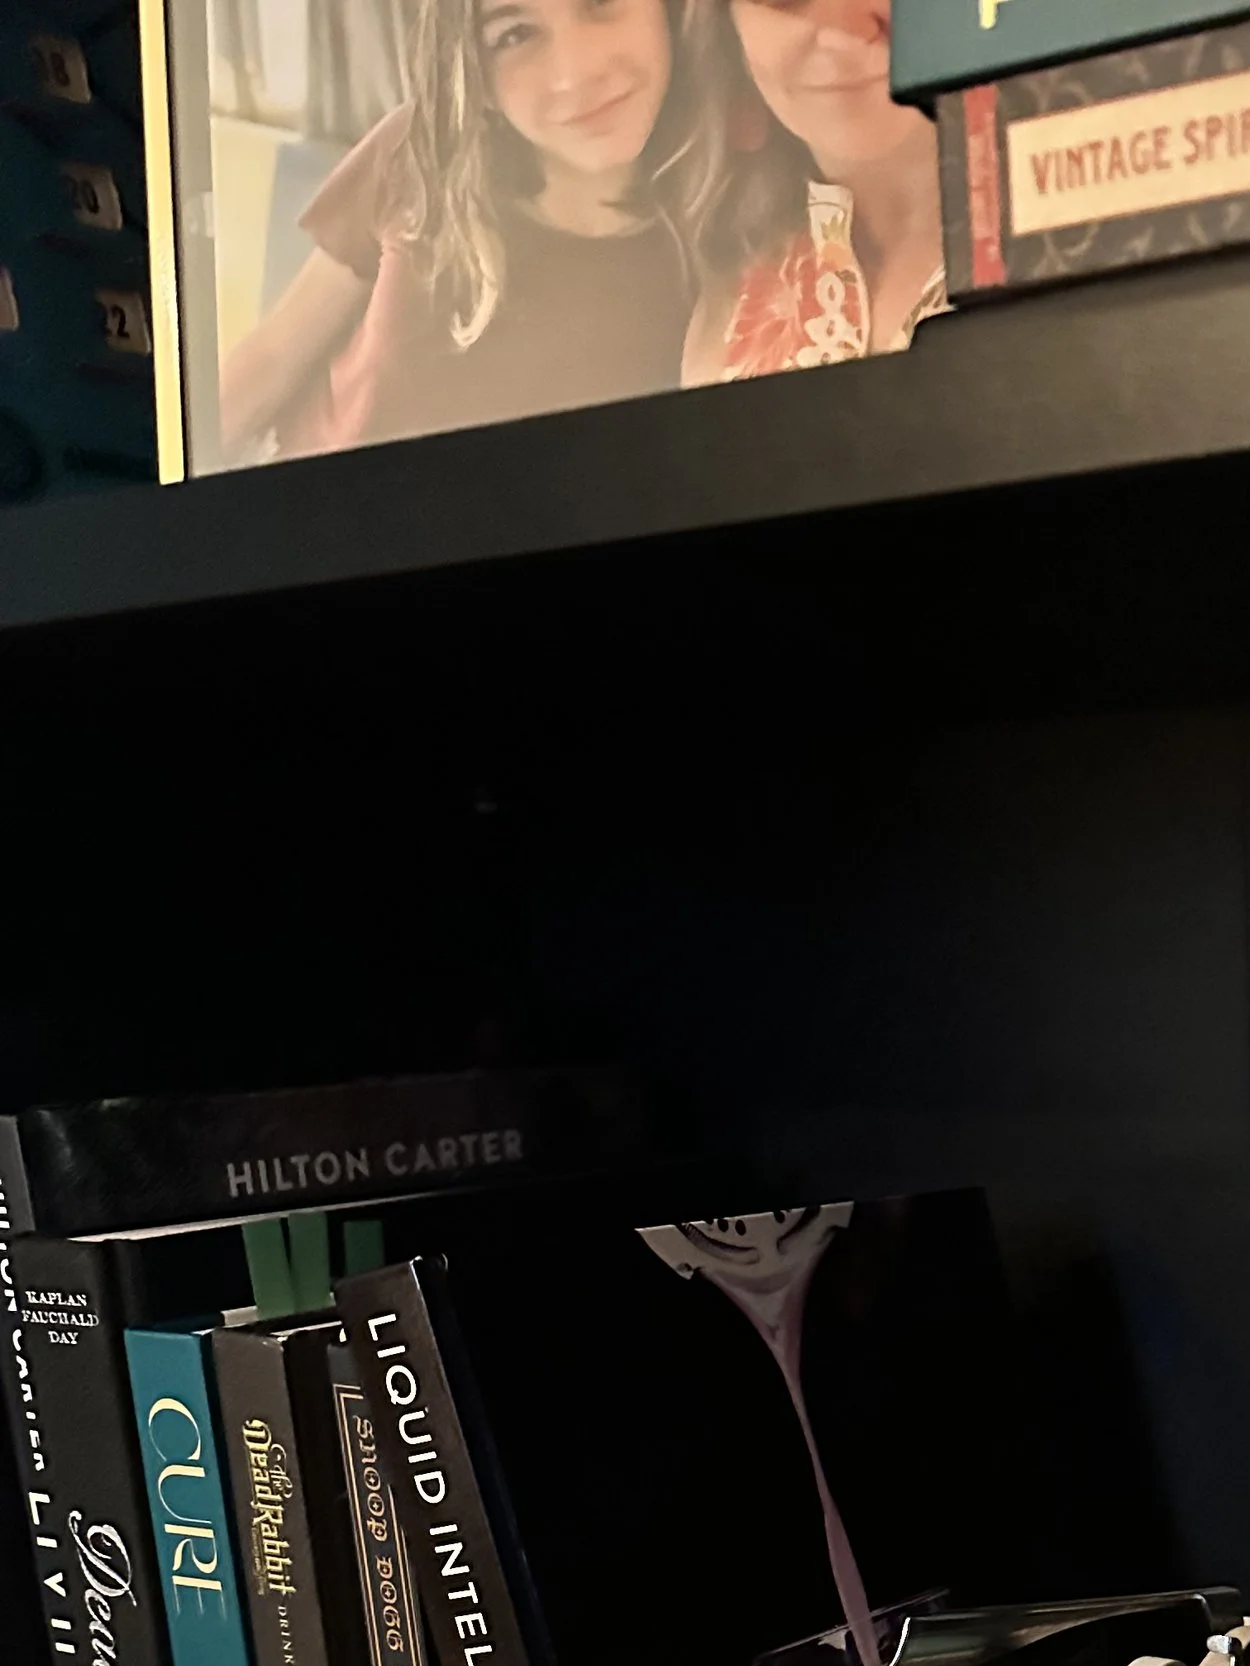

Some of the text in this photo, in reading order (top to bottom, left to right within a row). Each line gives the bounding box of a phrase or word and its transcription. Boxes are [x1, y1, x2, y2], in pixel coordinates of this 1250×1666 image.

[1029, 126, 1174, 196] VINTAGE
[226, 1128, 524, 1199] HILTON CARTER
[21, 1309, 100, 1328] FAUCHALD
[25, 1290, 88, 1308] KAPLAN
[48, 1330, 80, 1346] DAY
[366, 1312, 447, 1504] LIQUID
[147, 1397, 228, 1621] CURE
